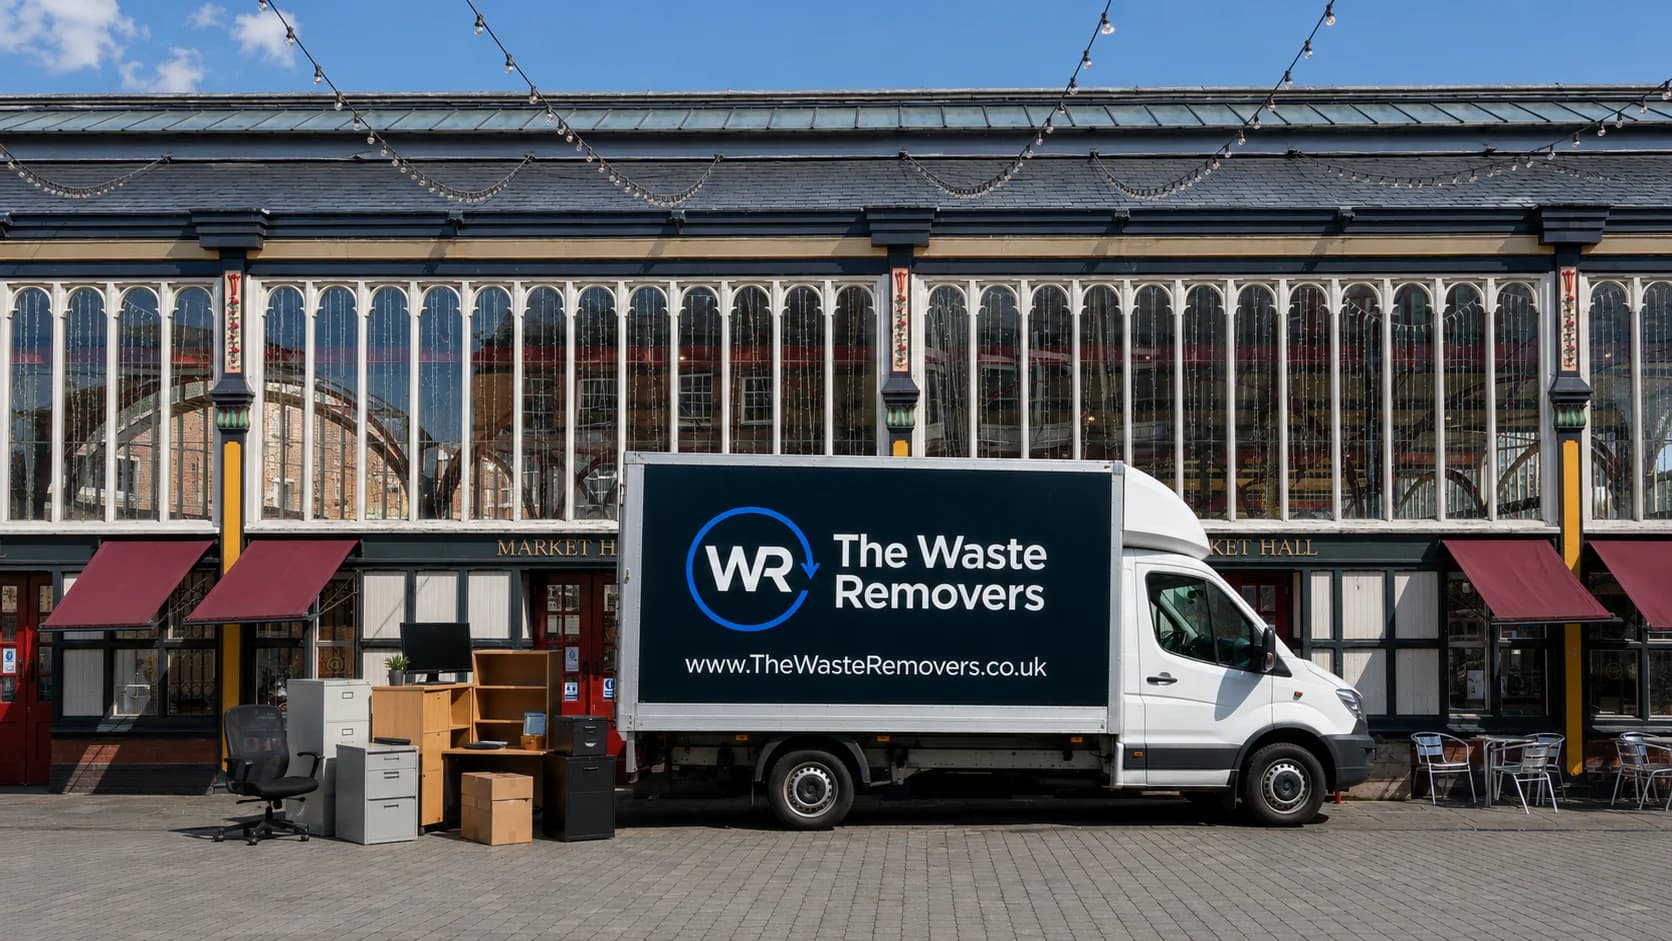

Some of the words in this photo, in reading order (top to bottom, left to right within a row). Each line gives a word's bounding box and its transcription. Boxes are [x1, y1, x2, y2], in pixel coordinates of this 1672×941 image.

[497, 539, 592, 556] MARKET
[833, 533, 908, 569] The
[917, 534, 1048, 571] Waste
[1260, 538, 1318, 556] HALL
[705, 545, 794, 593] WR
[835, 574, 1045, 612] Removers
[685, 653, 1047, 677] www.TheWasteRemovers.co.uk
